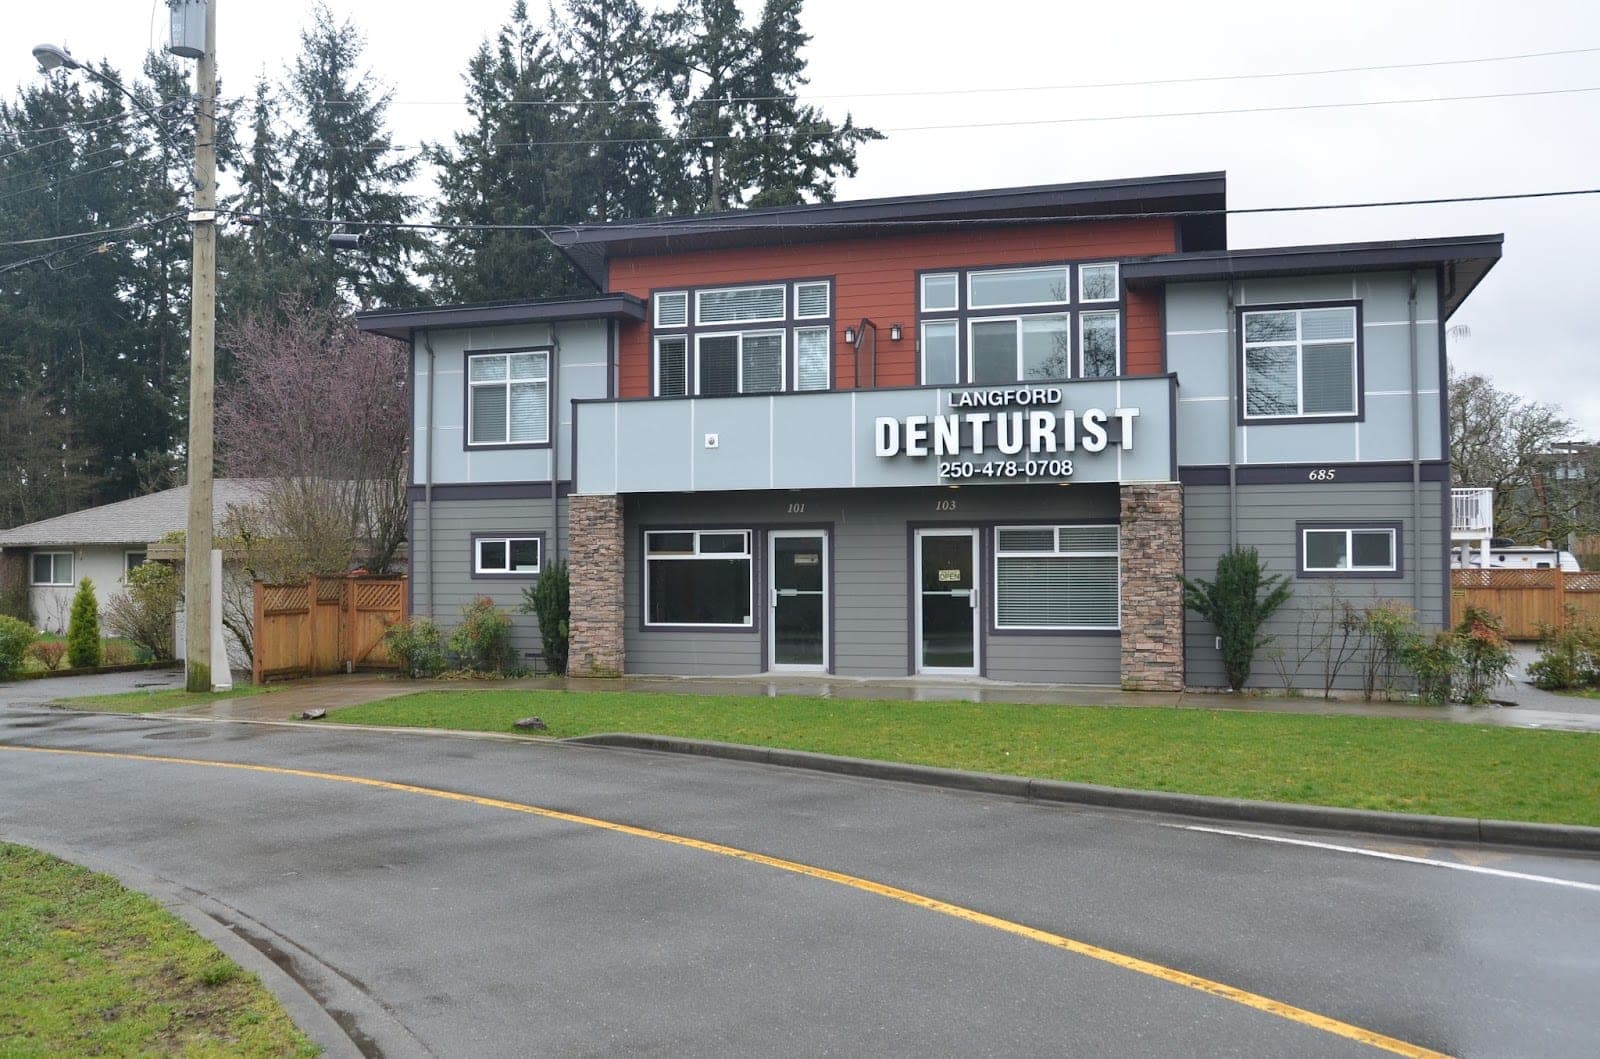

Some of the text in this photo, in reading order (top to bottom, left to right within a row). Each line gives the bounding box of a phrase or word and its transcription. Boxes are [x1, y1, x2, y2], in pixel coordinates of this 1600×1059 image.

[948, 388, 1062, 407] LANGFORD
[875, 408, 1140, 457] DENTURIST
[940, 460, 1073, 478] 250-478-0708
[1308, 469, 1336, 480] 685
[787, 503, 806, 513] 101
[936, 500, 956, 511] 103
